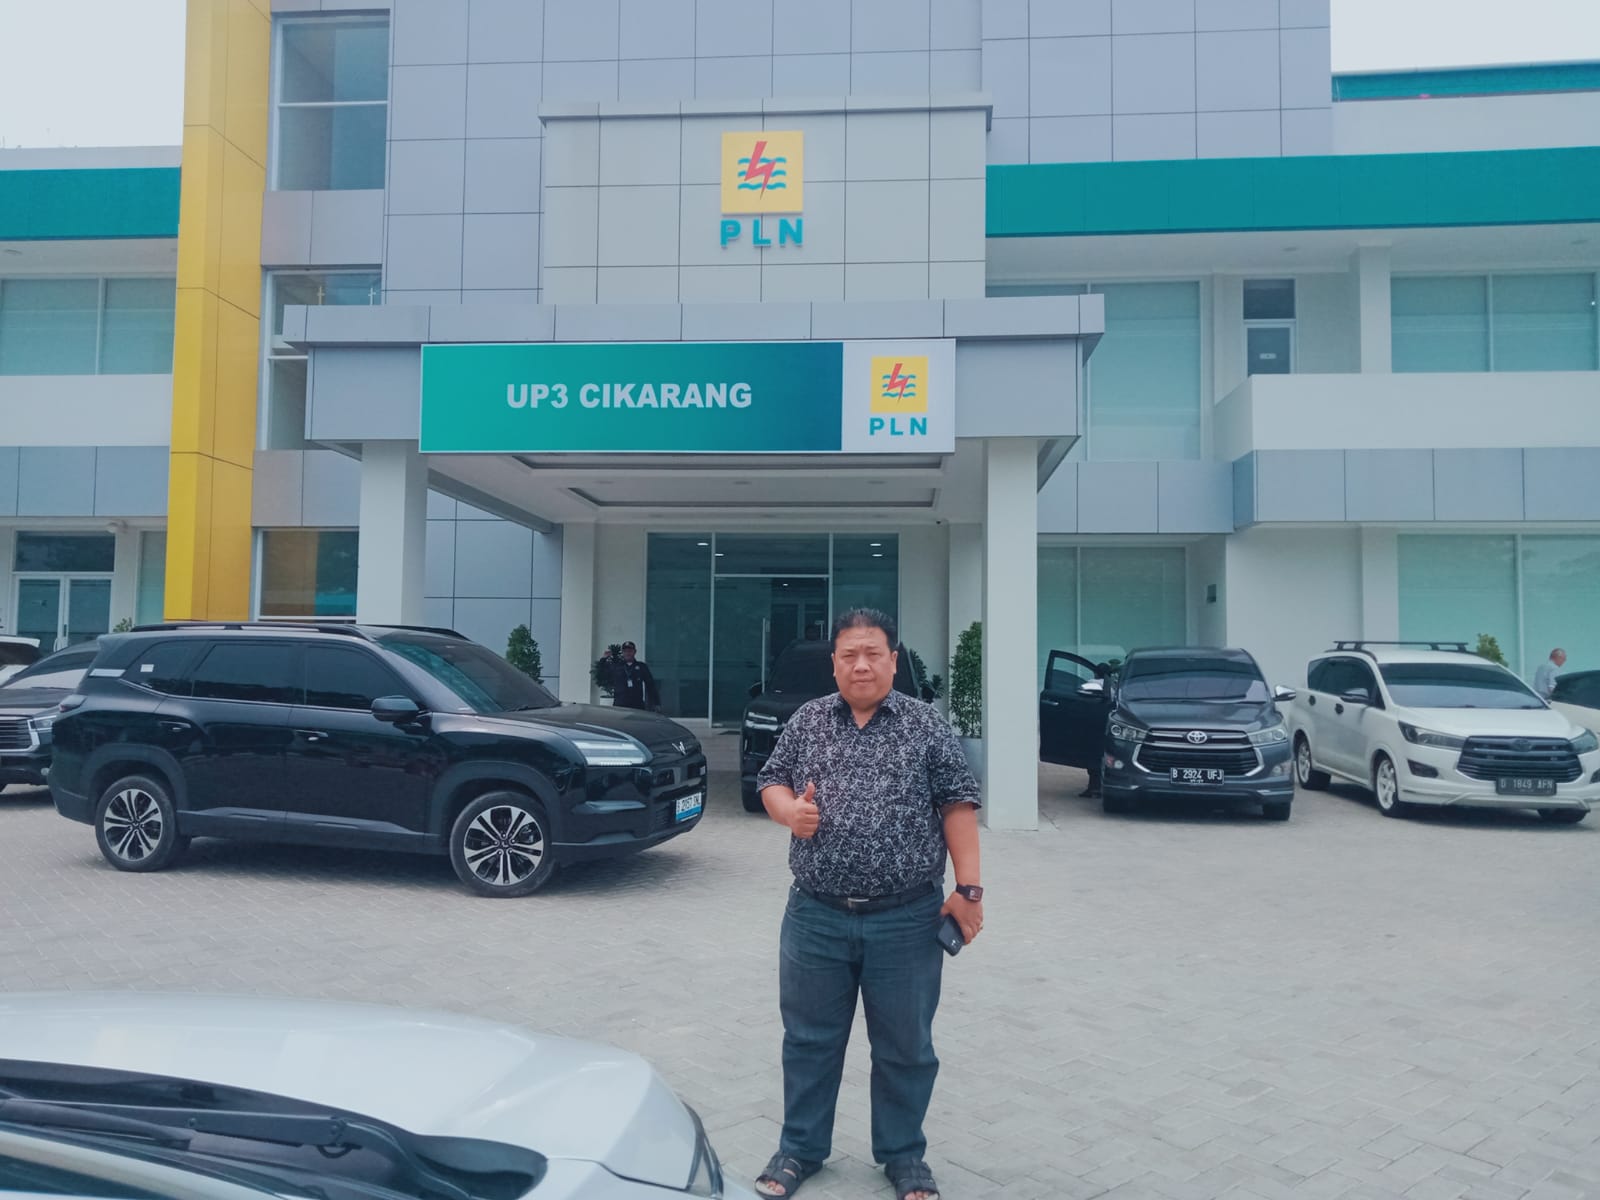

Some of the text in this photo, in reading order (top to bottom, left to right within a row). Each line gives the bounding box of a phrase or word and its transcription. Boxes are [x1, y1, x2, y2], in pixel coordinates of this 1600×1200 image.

[720, 218, 803, 247] PLN
[507, 383, 752, 409] UP3 CIKARANG
[869, 417, 927, 436] PLN
[1172, 768, 1178, 778] B
